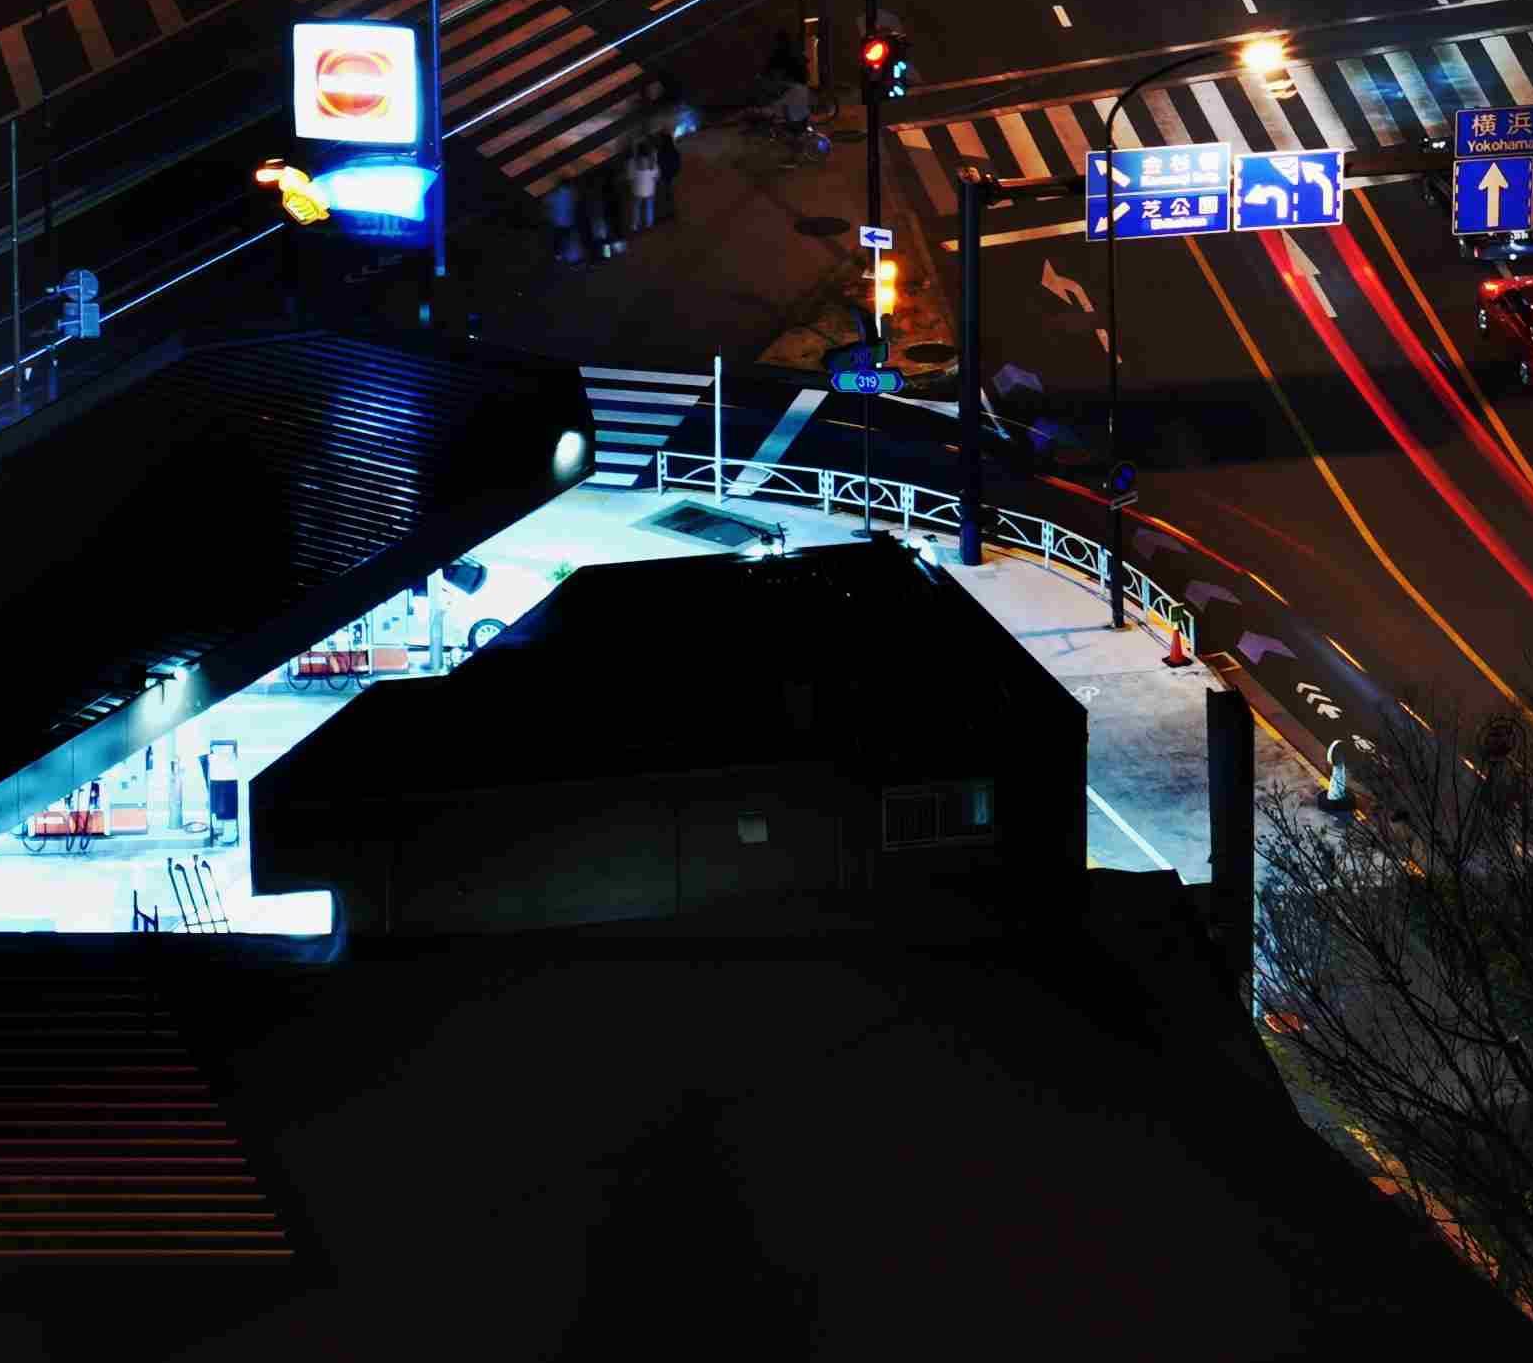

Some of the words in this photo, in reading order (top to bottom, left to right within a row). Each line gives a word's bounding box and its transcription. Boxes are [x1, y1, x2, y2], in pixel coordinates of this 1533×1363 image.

[1470, 112, 1533, 138] 横浜
[1142, 153, 1221, 175] 金杉
[858, 375, 878, 389] 319
